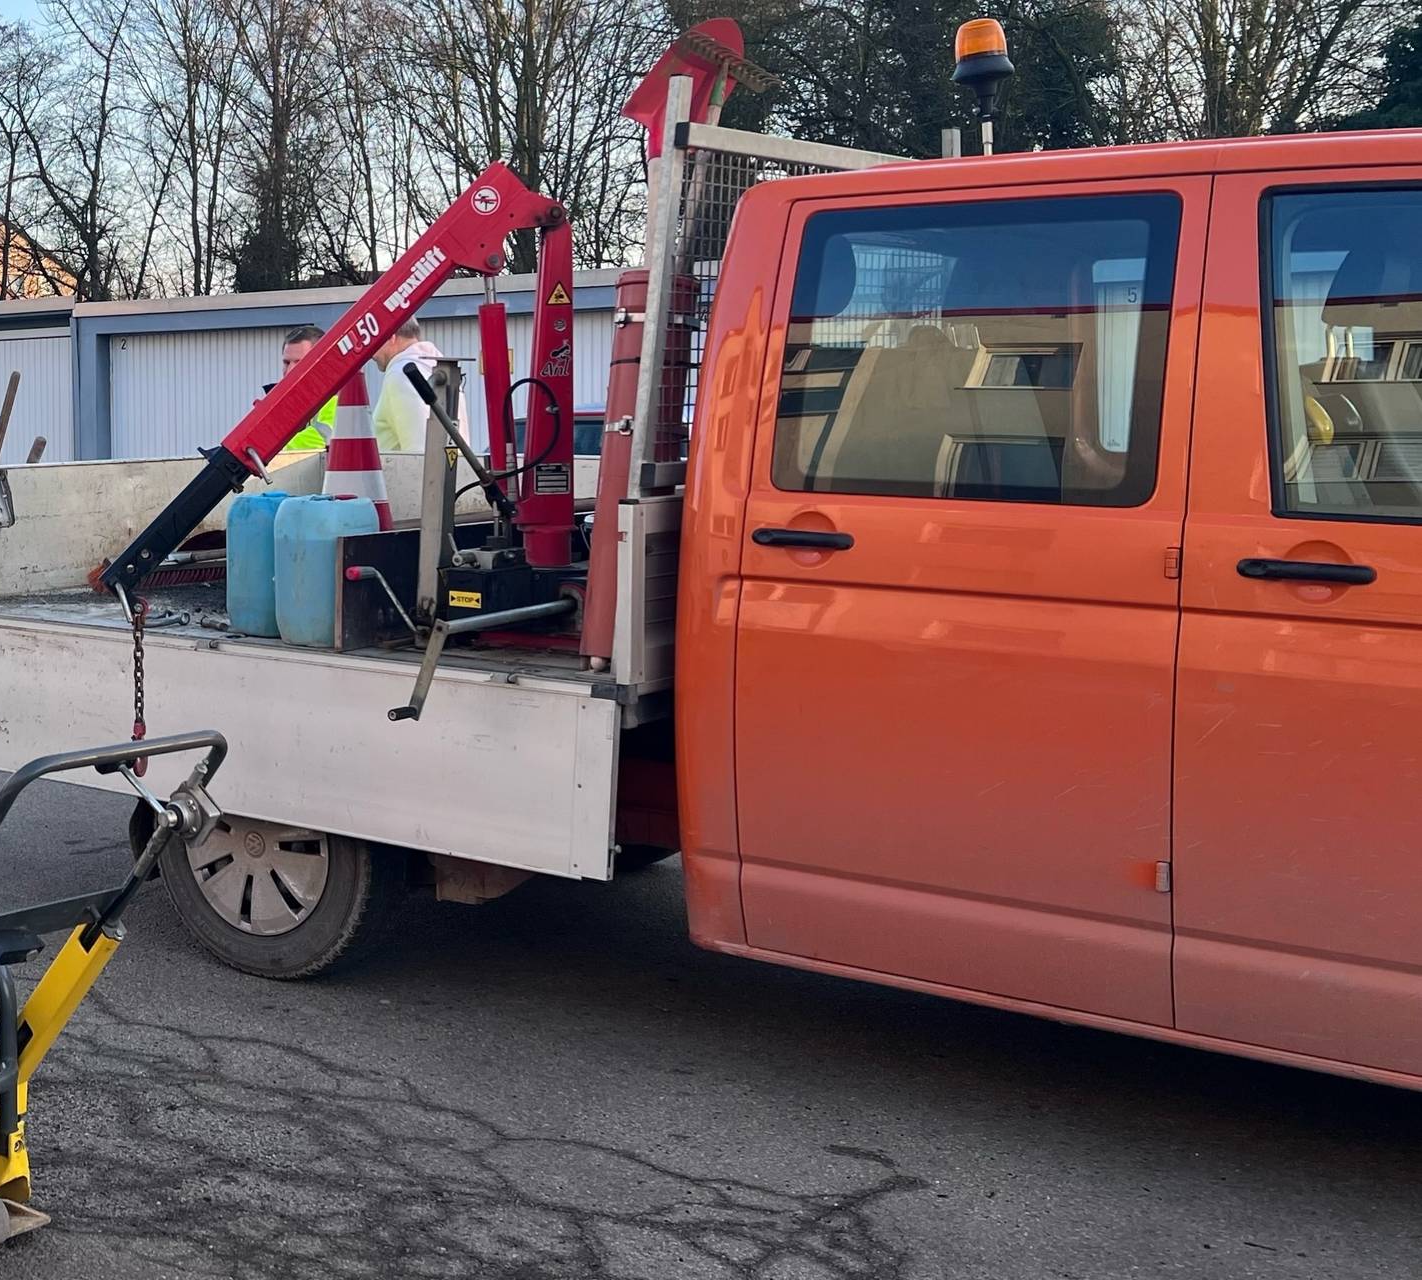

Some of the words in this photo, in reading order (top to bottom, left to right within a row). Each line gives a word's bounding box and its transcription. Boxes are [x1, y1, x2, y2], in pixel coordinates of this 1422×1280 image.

[382, 245, 447, 312] maxilift
[1127, 287, 1138, 304] 5
[121, 338, 127, 350] 2
[455, 595, 475, 604] STOP
